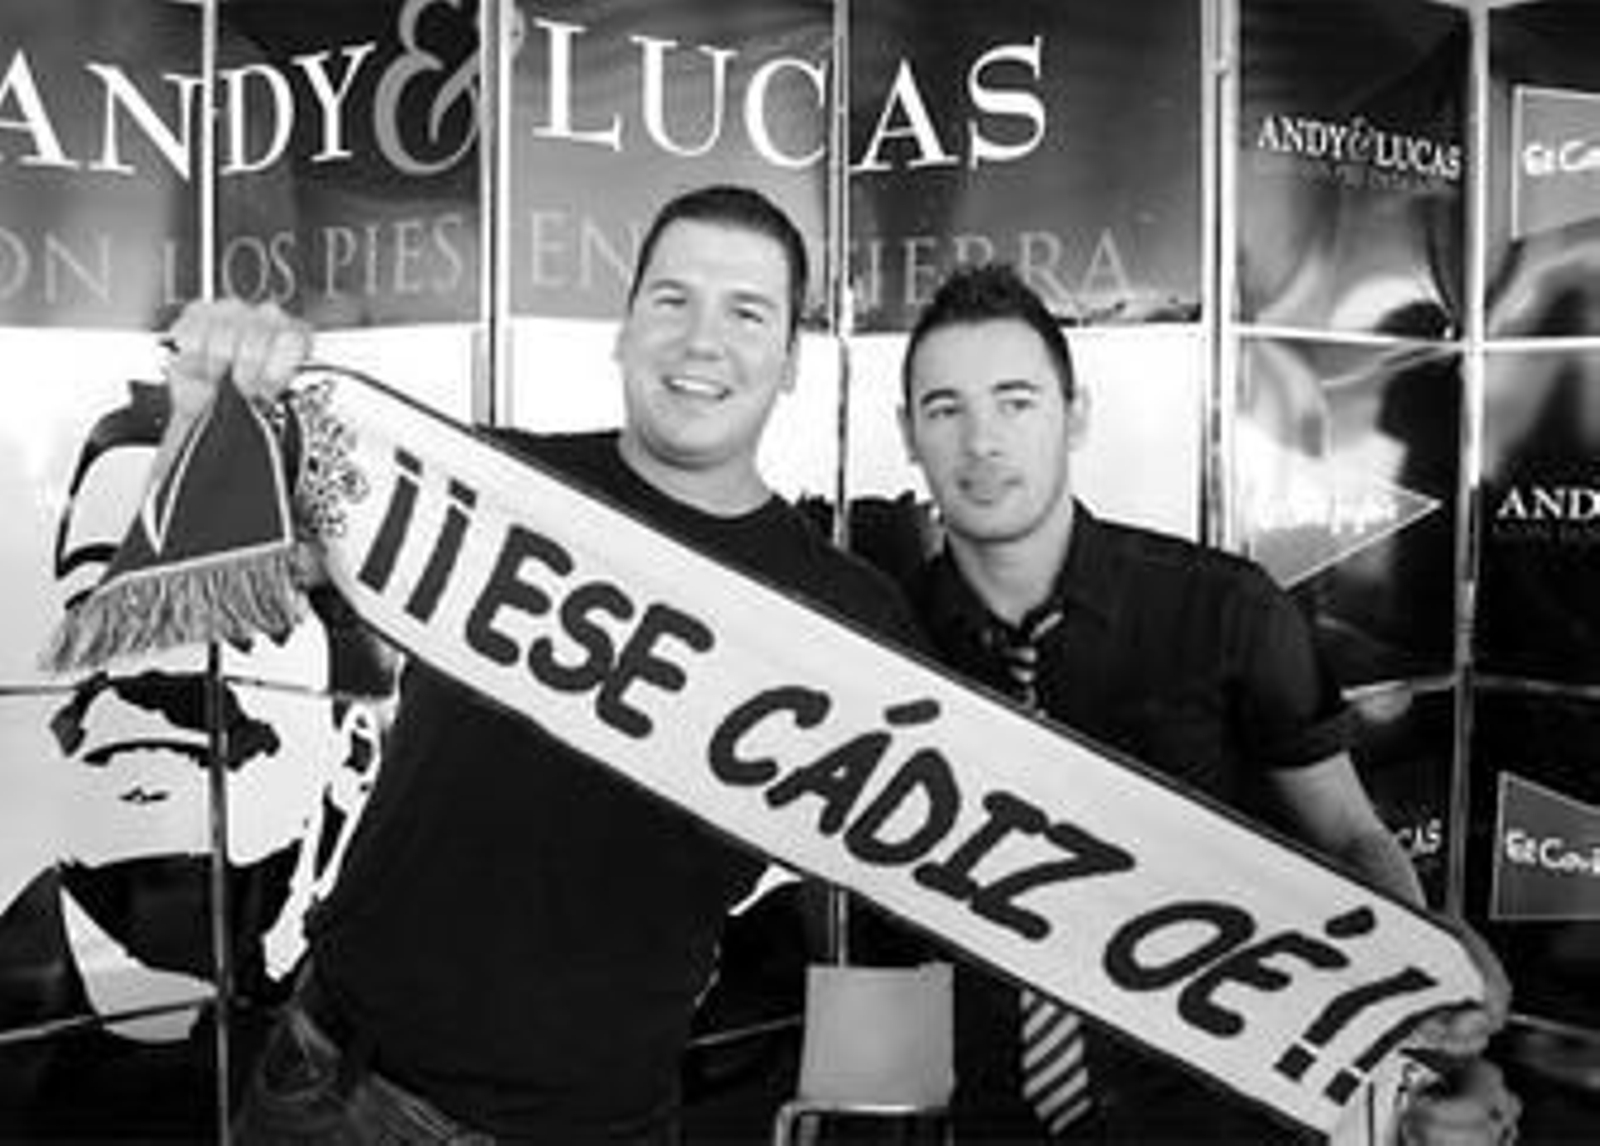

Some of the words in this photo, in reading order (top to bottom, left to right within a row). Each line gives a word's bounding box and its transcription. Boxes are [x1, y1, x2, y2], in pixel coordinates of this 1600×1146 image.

[533, 17, 1047, 175] LUCAS
[323, 212, 463, 299] PIES
[531, 207, 640, 291] EN
[854, 226, 1133, 310] IERRA
[707, 685, 1136, 941] CÁDIZ
